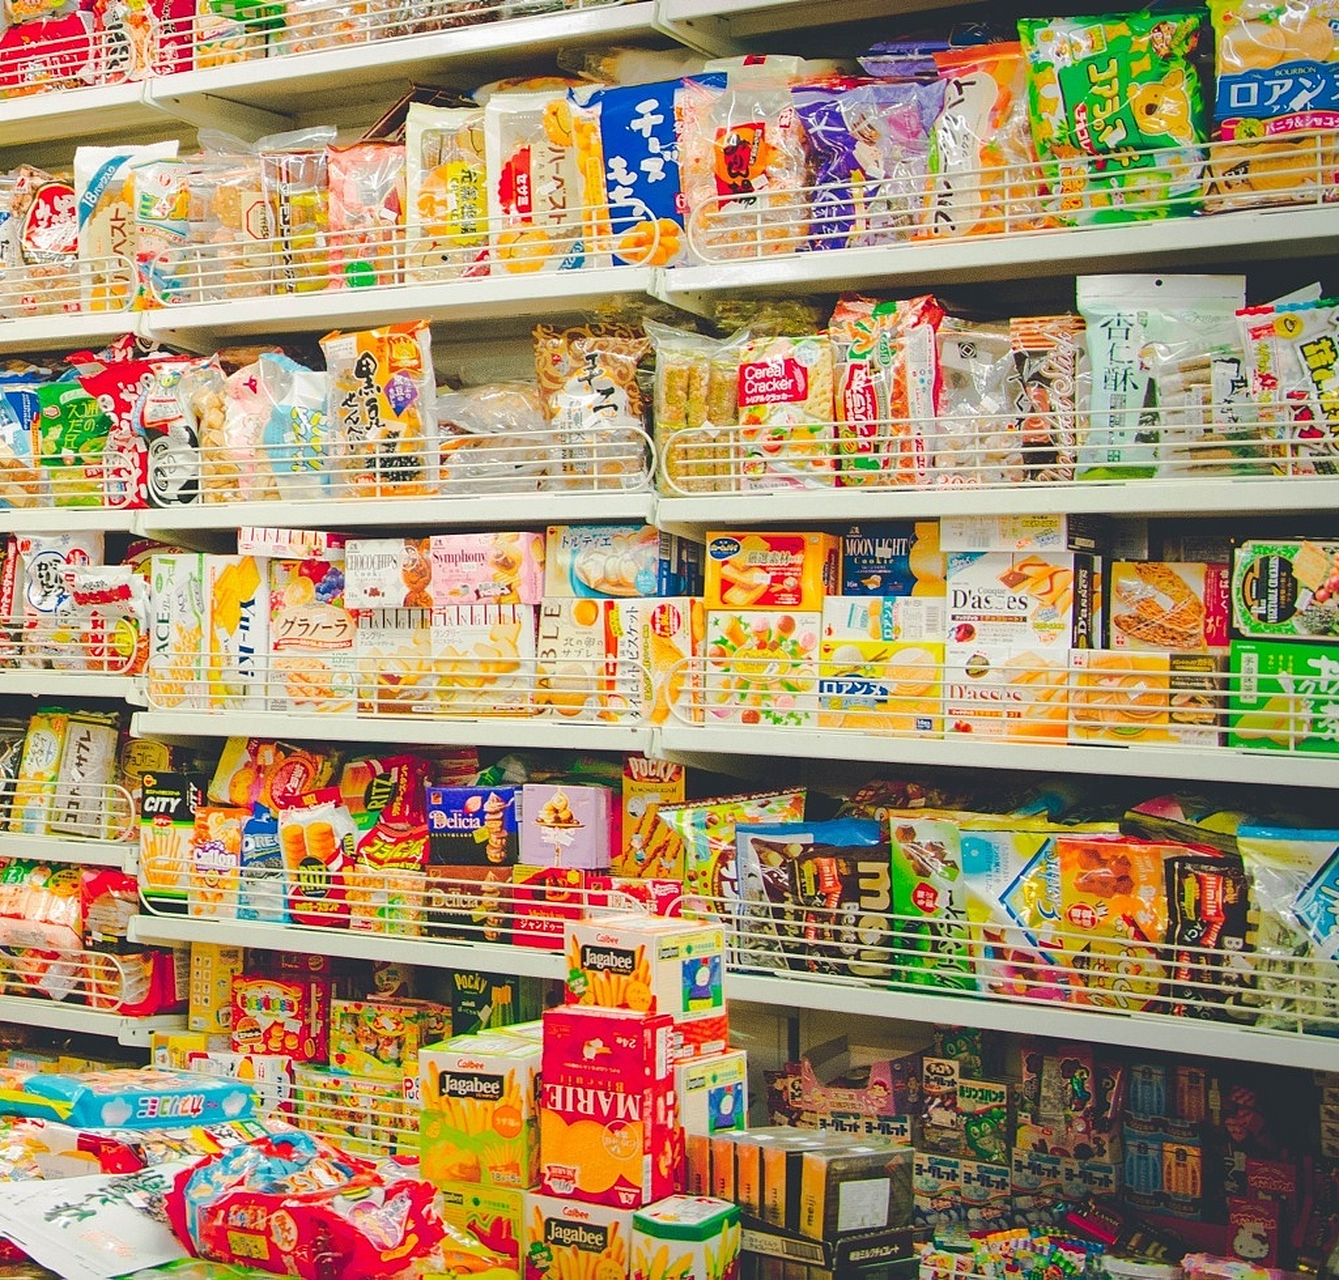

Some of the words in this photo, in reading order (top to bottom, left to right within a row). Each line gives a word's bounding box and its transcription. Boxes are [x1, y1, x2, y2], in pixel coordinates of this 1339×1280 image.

[1275, 66, 1316, 77] BOURBON
[1272, 103, 1314, 114] アソト
[546, 146, 568, 226] ハーベスト
[744, 364, 785, 381] Cereal
[744, 378, 794, 397] Cracker
[432, 549, 486, 568] Symphony
[279, 616, 350, 638] グラノーラ
[628, 756, 678, 783] POCKY
[367, 776, 392, 811] RITZ
[143, 796, 183, 814] CITY
[431, 810, 481, 830] Delicia
[584, 948, 633, 971] Jagabee
[442, 1075, 502, 1099] Jagabee
[544, 1084, 642, 1122] MARIE
[547, 1221, 605, 1247] Jagabee
